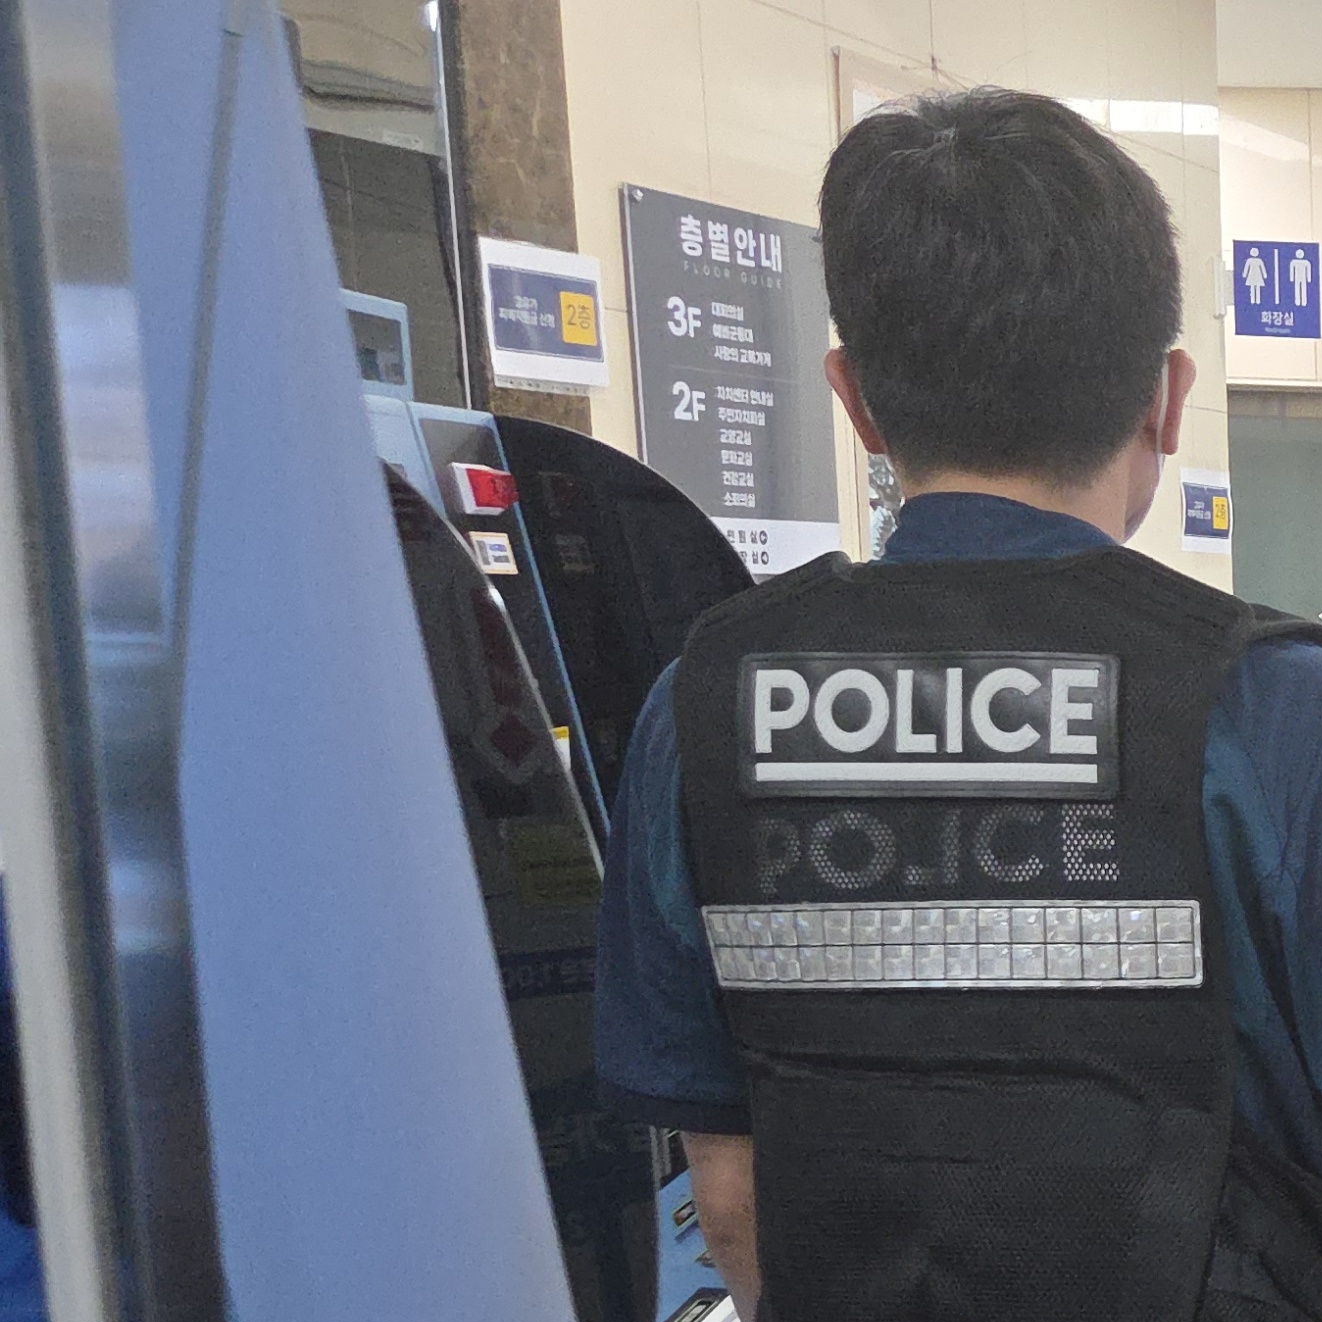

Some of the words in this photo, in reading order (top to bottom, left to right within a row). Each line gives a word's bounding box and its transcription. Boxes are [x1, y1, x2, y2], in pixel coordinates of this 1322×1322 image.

[680, 214, 783, 274] 층별안내
[683, 260, 731, 279] FLOOR
[740, 271, 783, 290] GUIDE
[566, 303, 592, 330] 2층
[666, 295, 702, 338] 3F
[1261, 310, 1294, 326] 화장실
[672, 380, 706, 422] 2F
[755, 667, 1099, 755] POLICE
[758, 804, 1120, 896] POLICE
